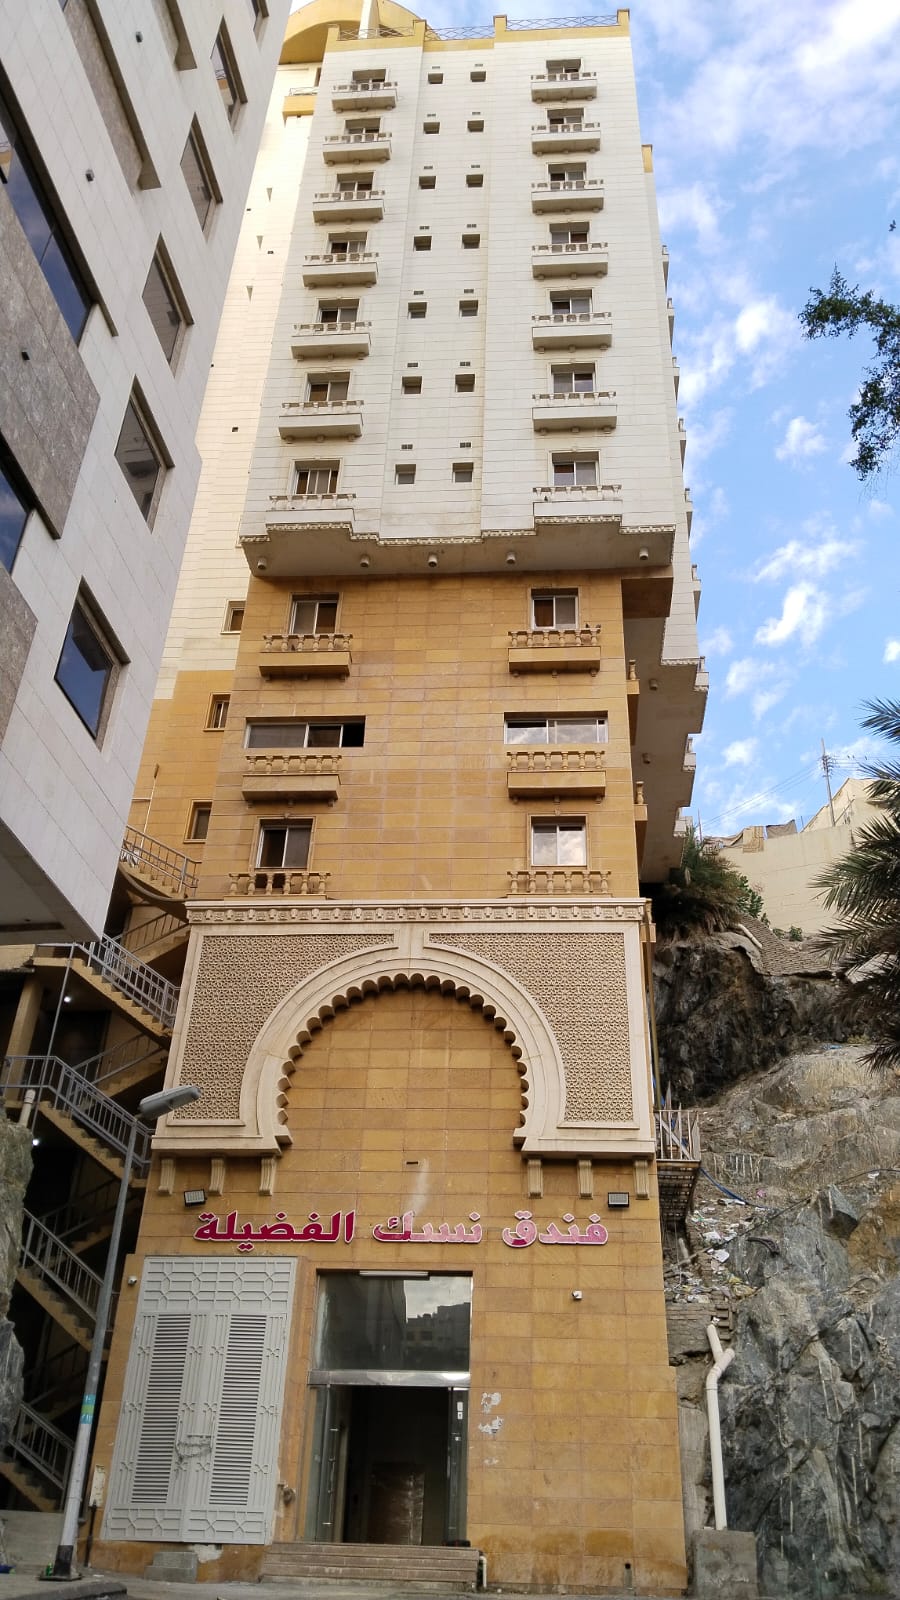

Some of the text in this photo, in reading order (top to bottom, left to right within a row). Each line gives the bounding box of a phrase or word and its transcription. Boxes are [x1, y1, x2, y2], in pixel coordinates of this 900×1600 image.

[194, 1210, 608, 1252] فندق نسك الفضيلة
